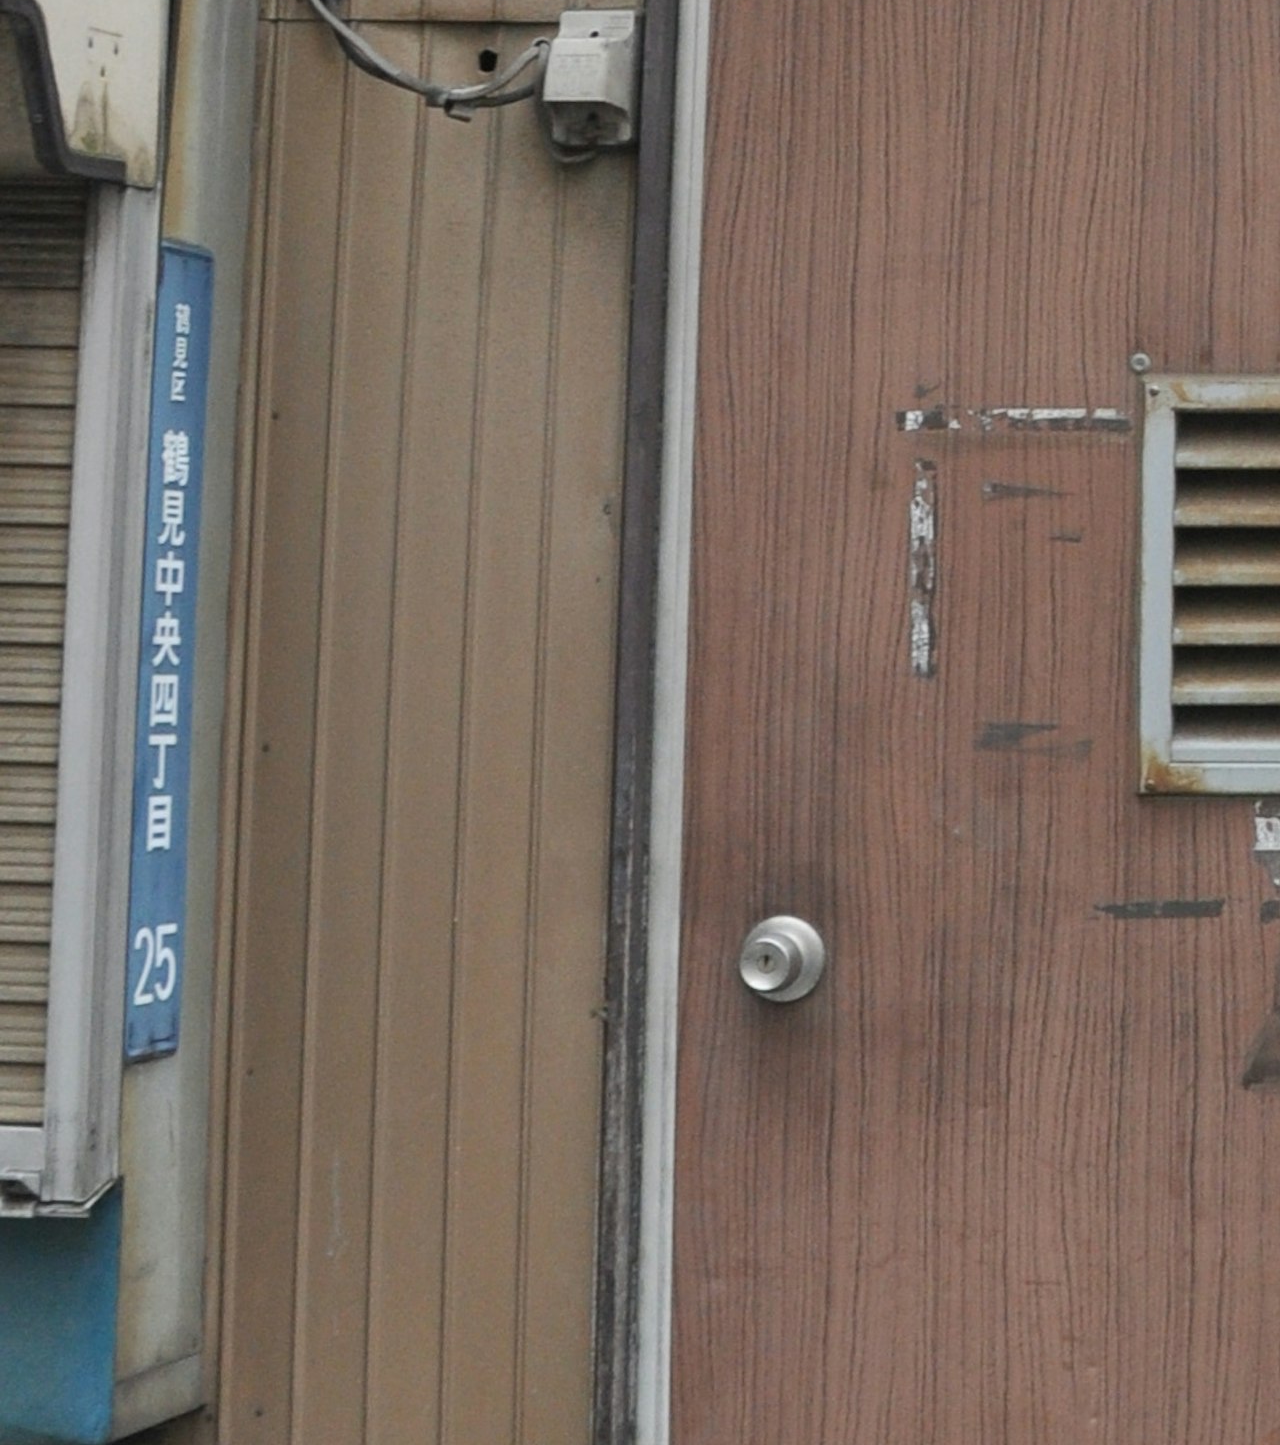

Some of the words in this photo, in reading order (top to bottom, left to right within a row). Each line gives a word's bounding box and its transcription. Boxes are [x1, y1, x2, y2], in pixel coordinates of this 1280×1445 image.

[146, 429, 190, 852] 鶴見中央四丁目
[133, 922, 178, 1006] 25
